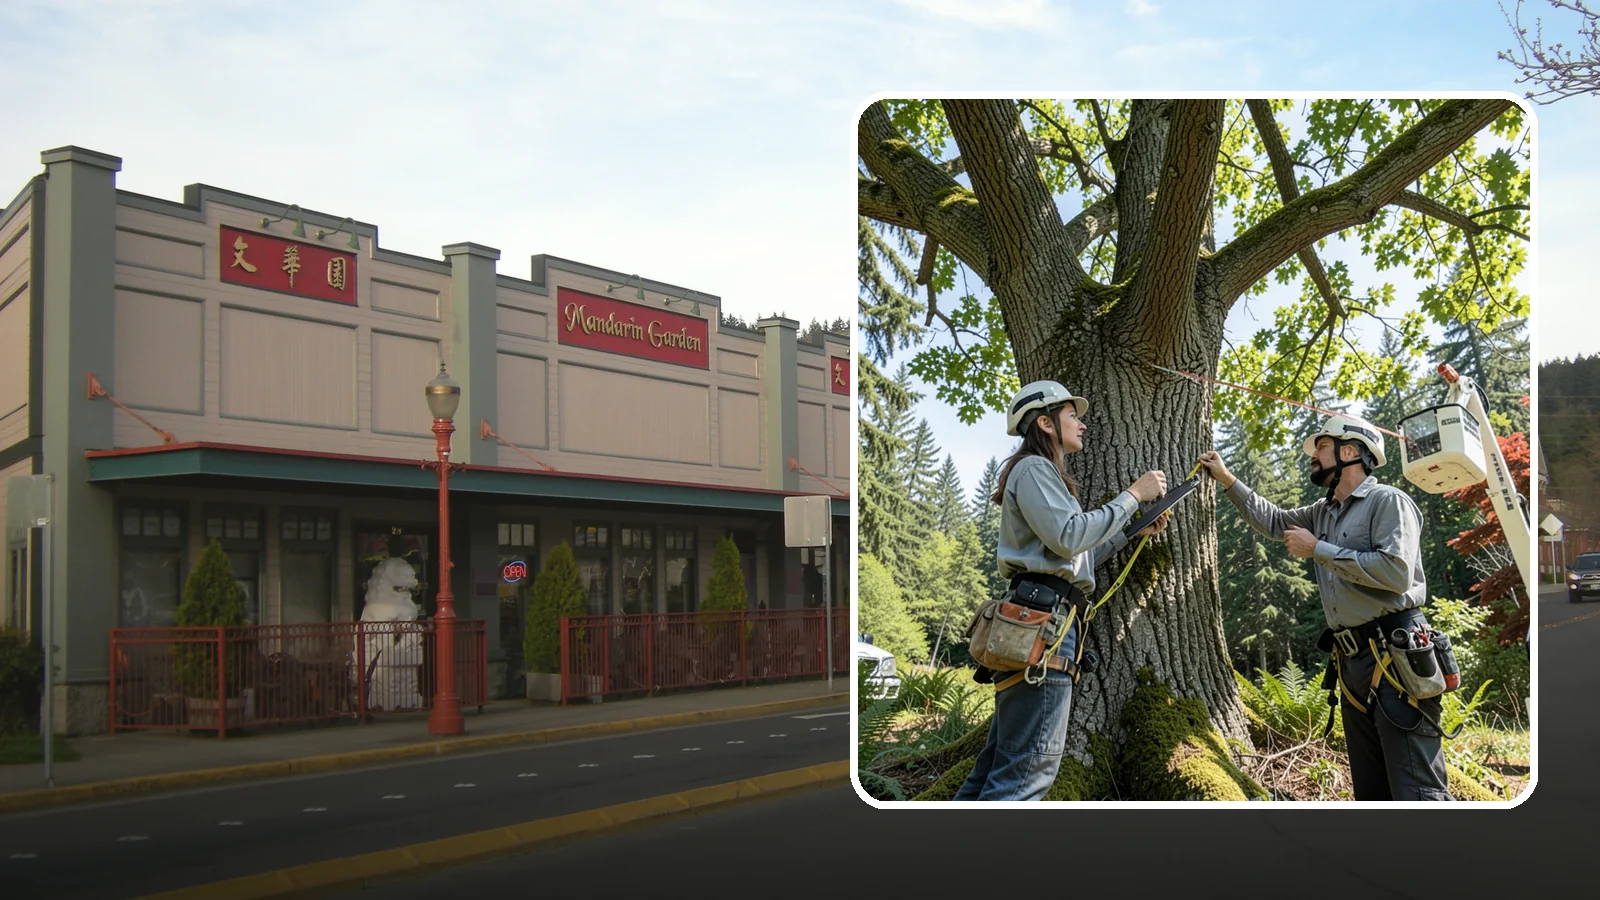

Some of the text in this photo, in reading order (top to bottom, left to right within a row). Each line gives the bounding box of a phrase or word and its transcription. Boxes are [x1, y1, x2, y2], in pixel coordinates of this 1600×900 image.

[230, 235, 346, 291] 文華園
[564, 302, 701, 352] Mandarin Garden
[503, 565, 527, 578] OPEN
